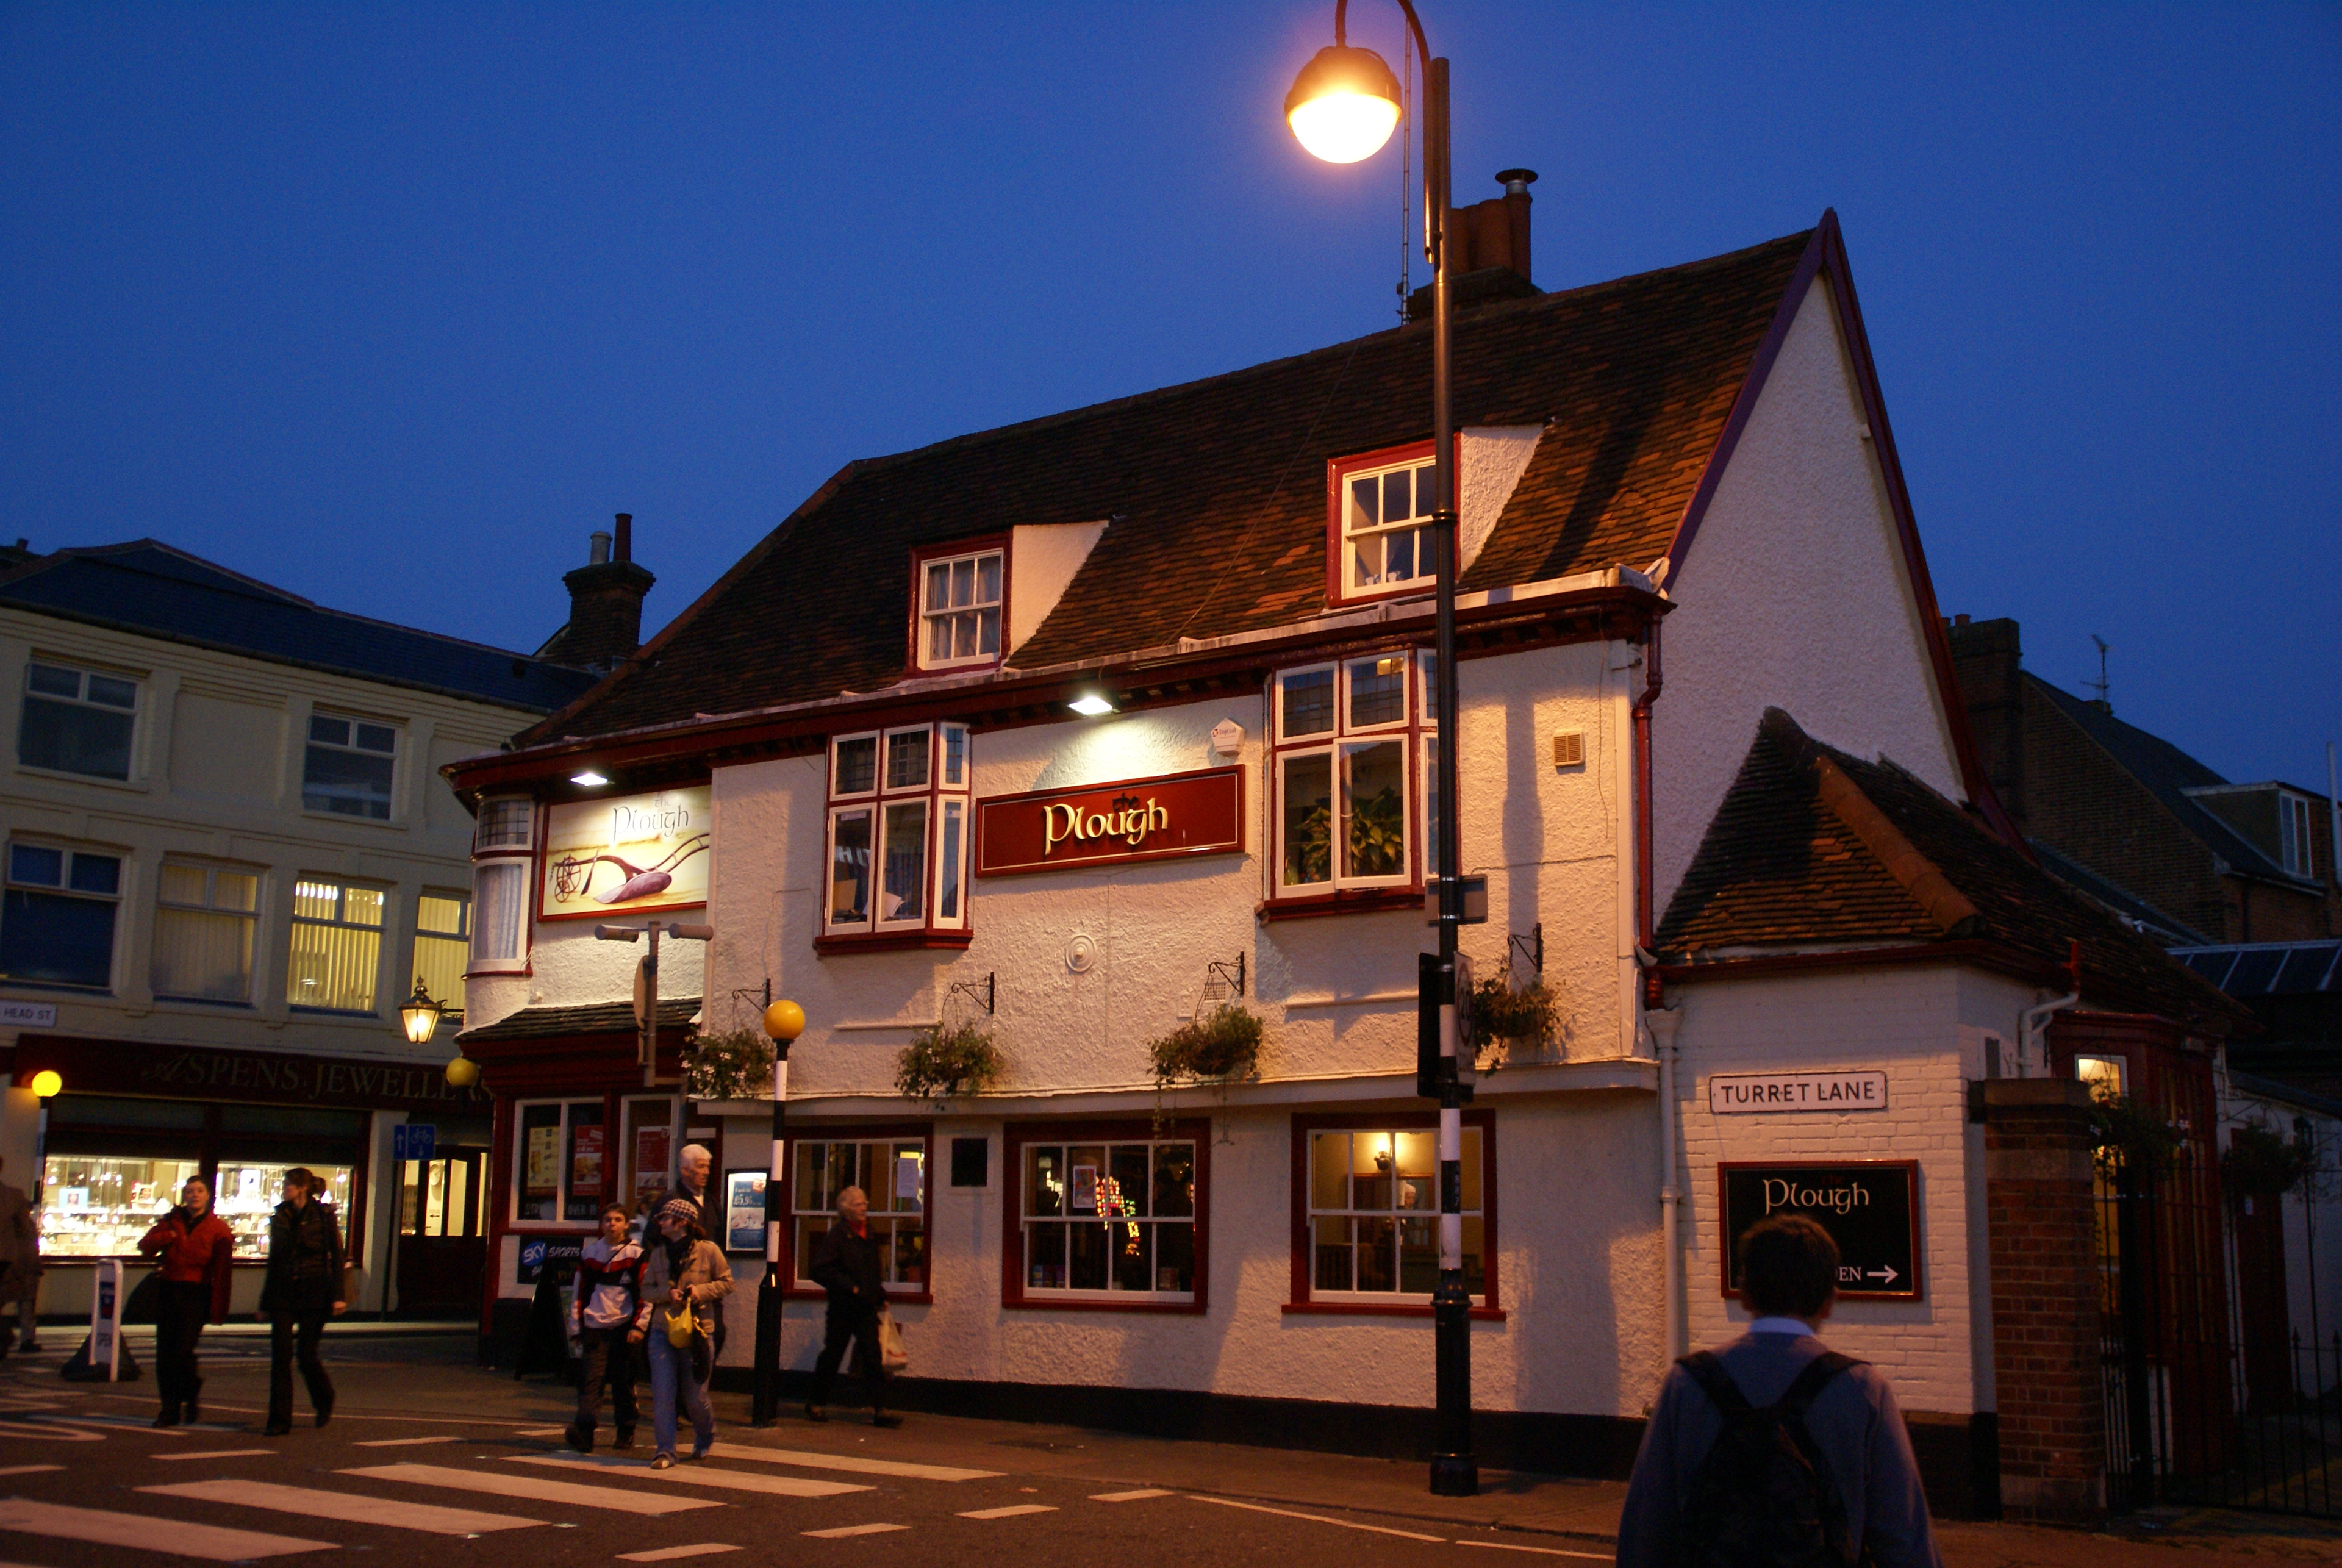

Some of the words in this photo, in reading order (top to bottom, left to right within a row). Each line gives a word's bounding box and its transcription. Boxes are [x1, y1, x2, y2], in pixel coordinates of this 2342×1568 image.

[654, 795, 671, 808] the
[1112, 793, 1140, 812] the
[614, 805, 689, 842] Plough
[1043, 797, 1168, 856] Plough
[4, 1008, 33, 1018] HEAD
[38, 1010, 51, 1020] ST
[1721, 1083, 1810, 1104] TURRET
[1817, 1081, 1875, 1101] LANE
[1763, 1178, 1869, 1215] Plough
[523, 1243, 546, 1264] SKY
[549, 1246, 581, 1257] SPORTS
